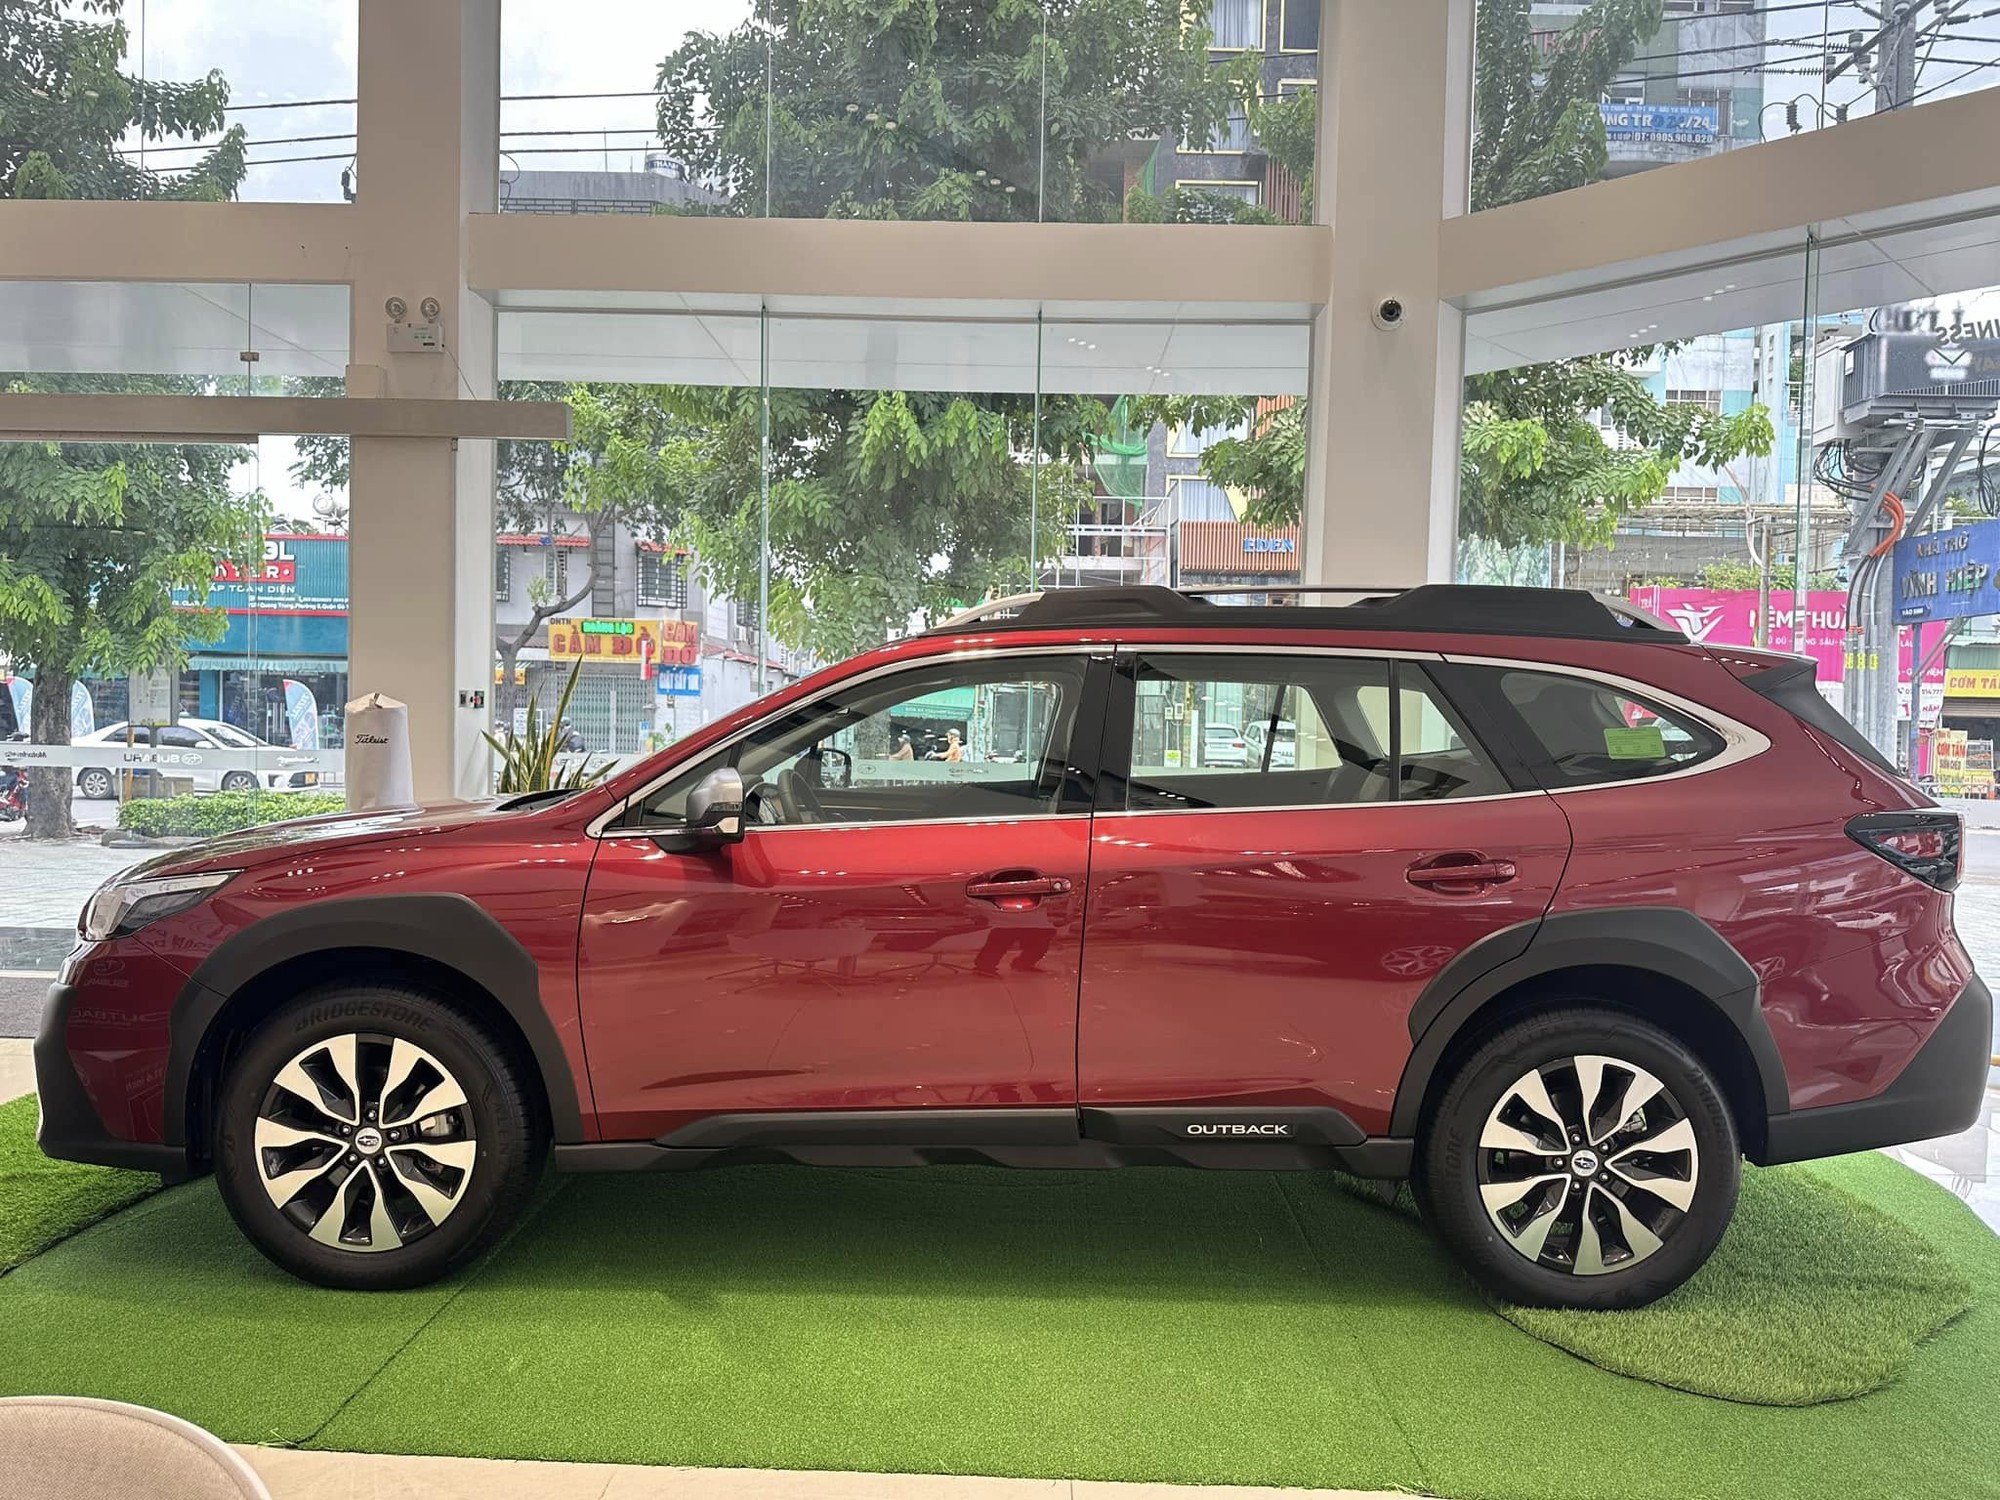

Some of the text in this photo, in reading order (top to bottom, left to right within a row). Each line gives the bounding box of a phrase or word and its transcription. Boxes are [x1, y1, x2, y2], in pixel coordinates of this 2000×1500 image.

[1243, 538, 1294, 553] EDEN
[1980, 673, 2000, 690] TẤ
[296, 1001, 437, 1034] BRIDGESTONE
[1187, 1124, 1289, 1135] OUTBACK
